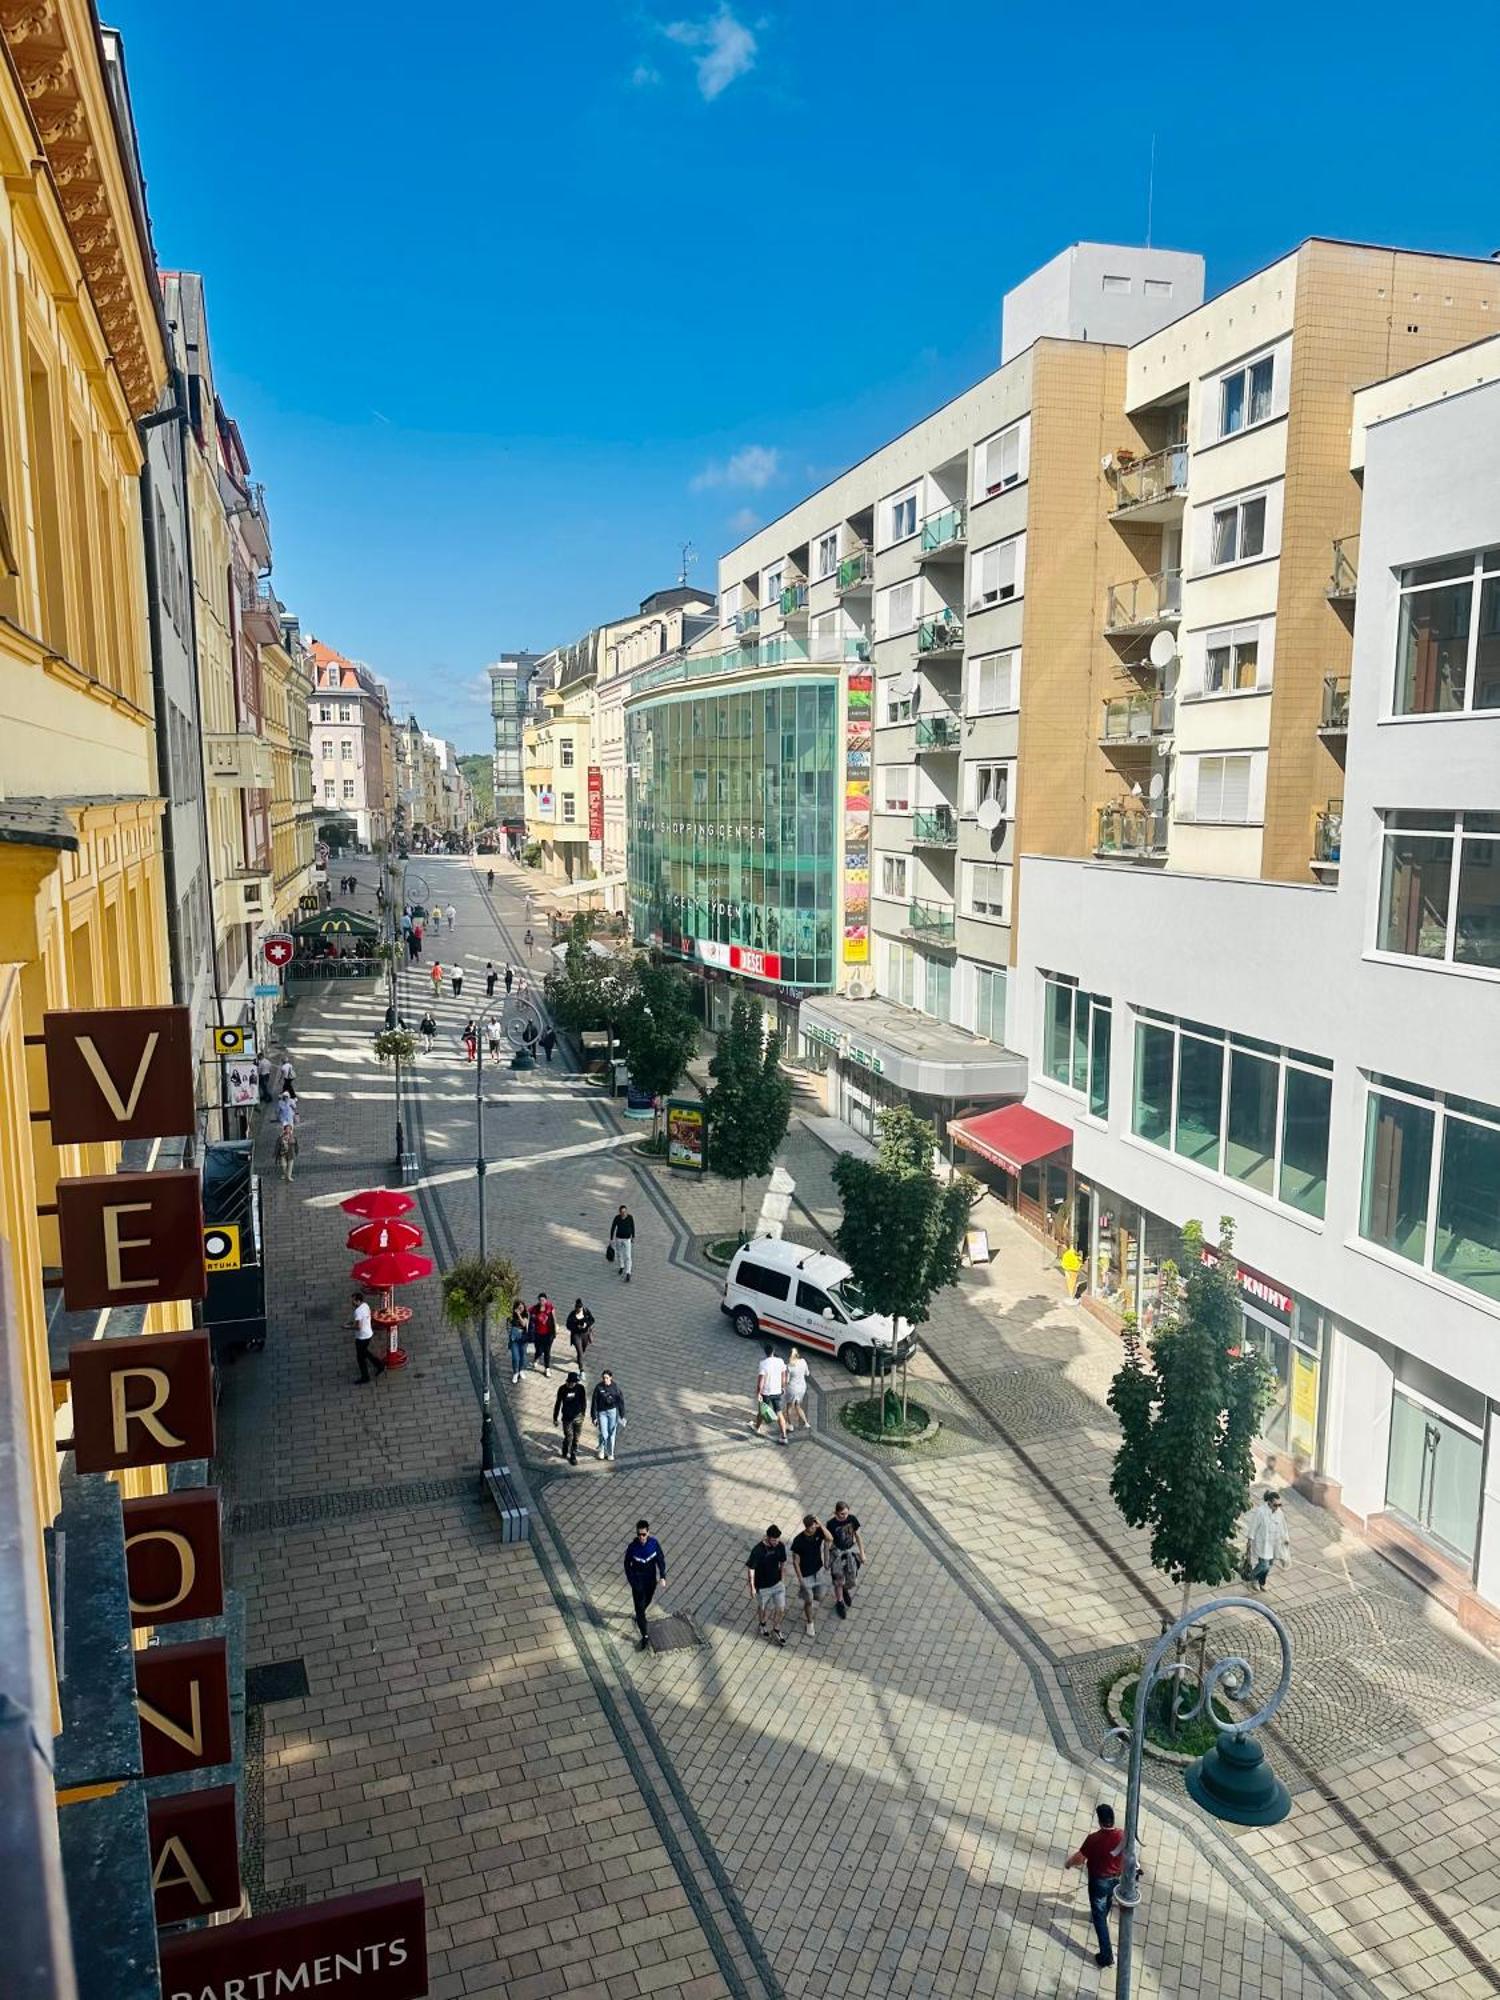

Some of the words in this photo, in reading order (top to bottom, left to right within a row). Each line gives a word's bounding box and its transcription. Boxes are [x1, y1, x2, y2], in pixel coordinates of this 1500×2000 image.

[660, 822, 714, 836] SHOPPING
[719, 824, 765, 840] CENTER
[741, 950, 764, 975] DIESEL
[1243, 1272, 1289, 1312] KNIHY
[171, 1938, 408, 2000] ARTMENTS
